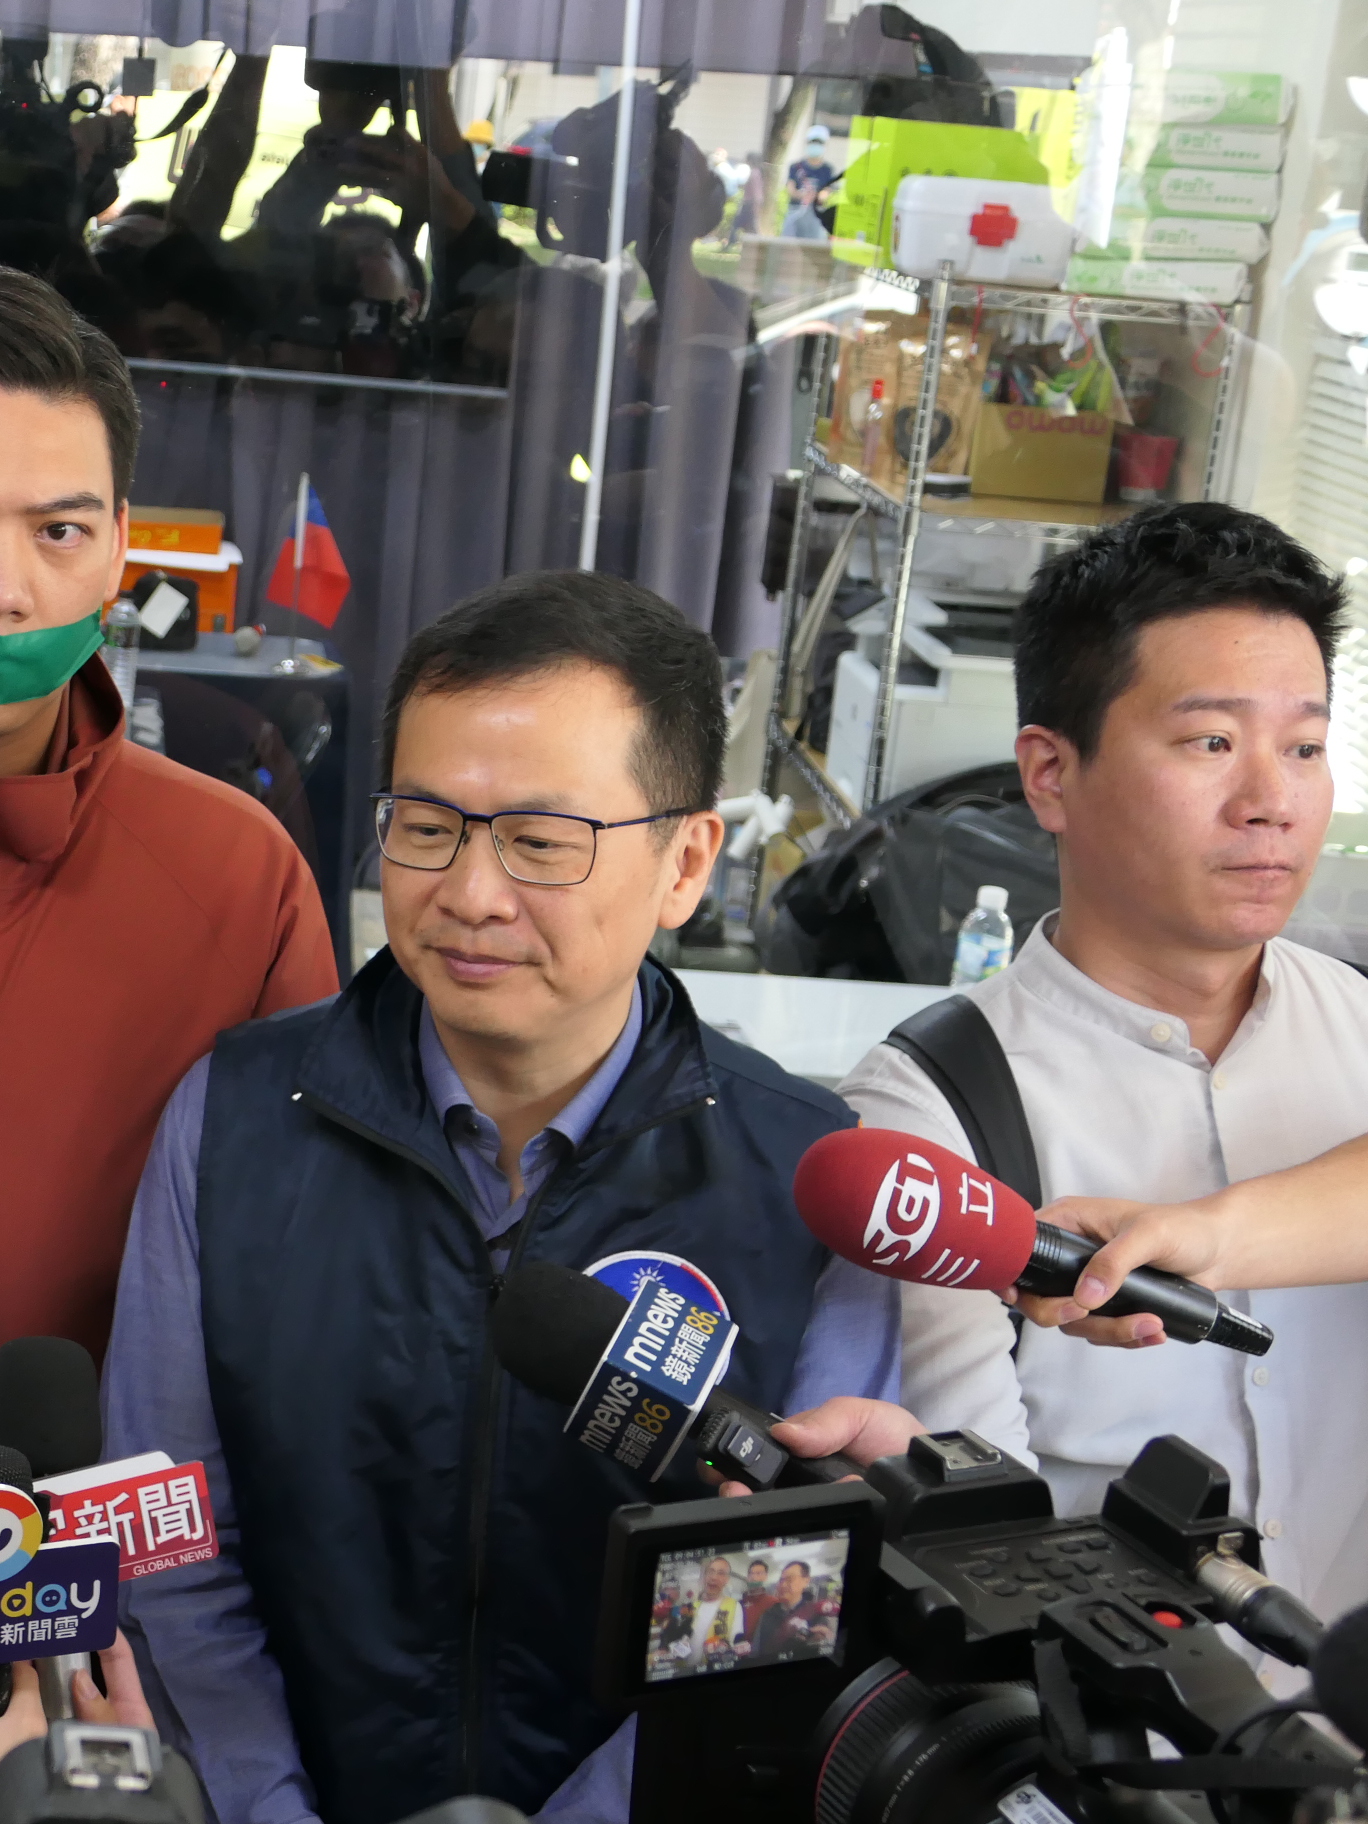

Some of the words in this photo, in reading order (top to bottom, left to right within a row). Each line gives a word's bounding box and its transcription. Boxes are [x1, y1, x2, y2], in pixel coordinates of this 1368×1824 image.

[624, 1287, 686, 1372] mnews
[133, 1555, 178, 1576] GLOBAL
[179, 1547, 213, 1566] NEWS
[0, 1615, 79, 1646] 新聞雲
